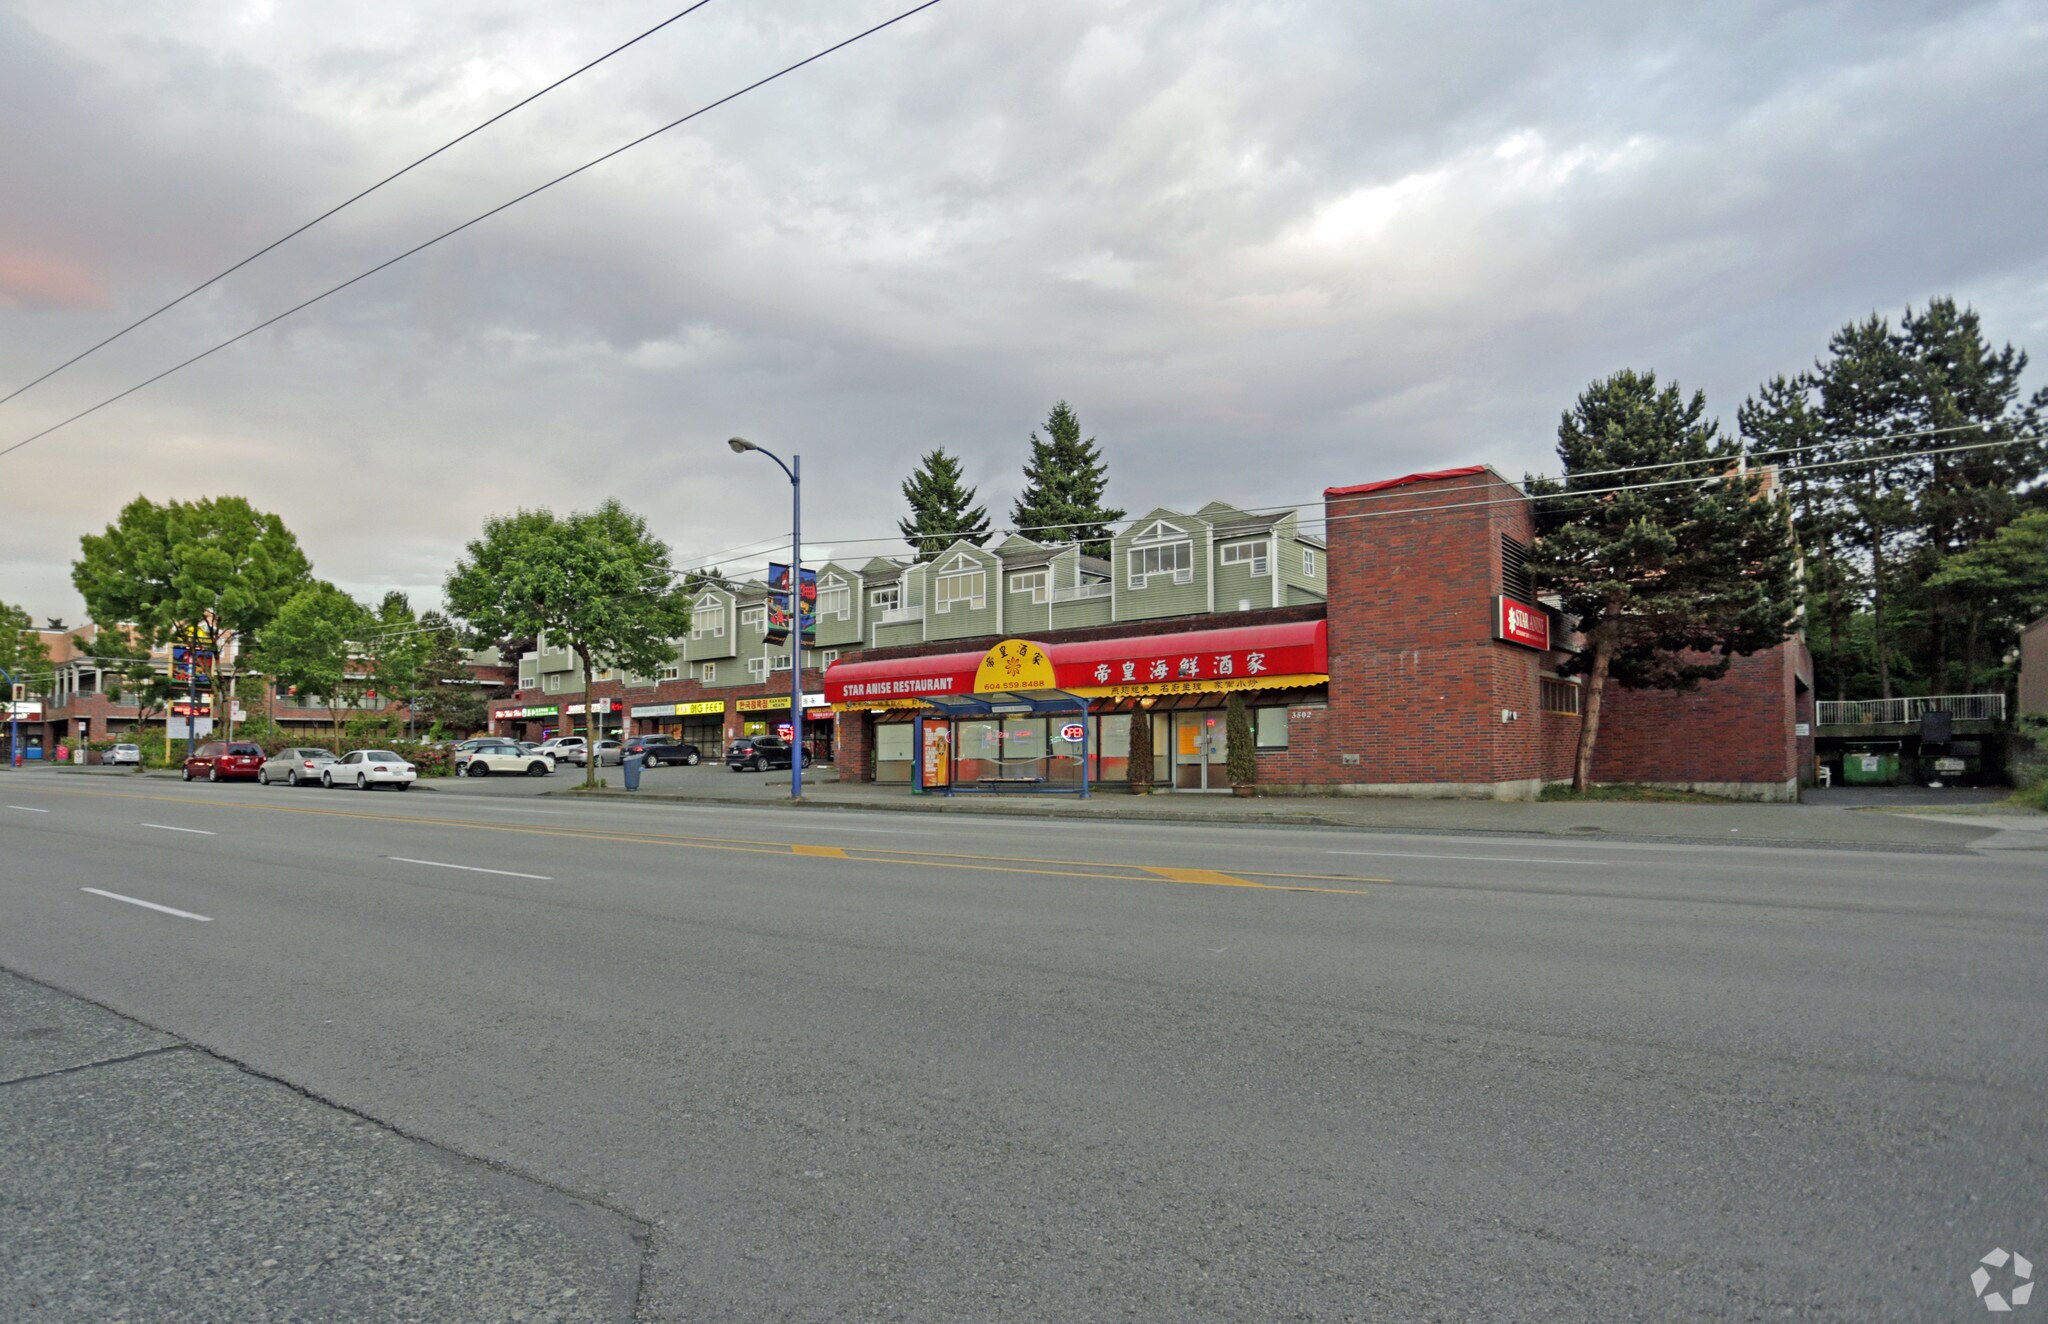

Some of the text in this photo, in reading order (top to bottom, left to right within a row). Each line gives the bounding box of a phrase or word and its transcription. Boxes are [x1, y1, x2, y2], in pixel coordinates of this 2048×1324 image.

[843, 677, 953, 697] STAR ANISE RESTAURANT
[984, 680, 1045, 691] 604.559.8488
[690, 703, 703, 714] BIG
[705, 702, 723, 712] FEET
[1291, 711, 1312, 719] 3502
